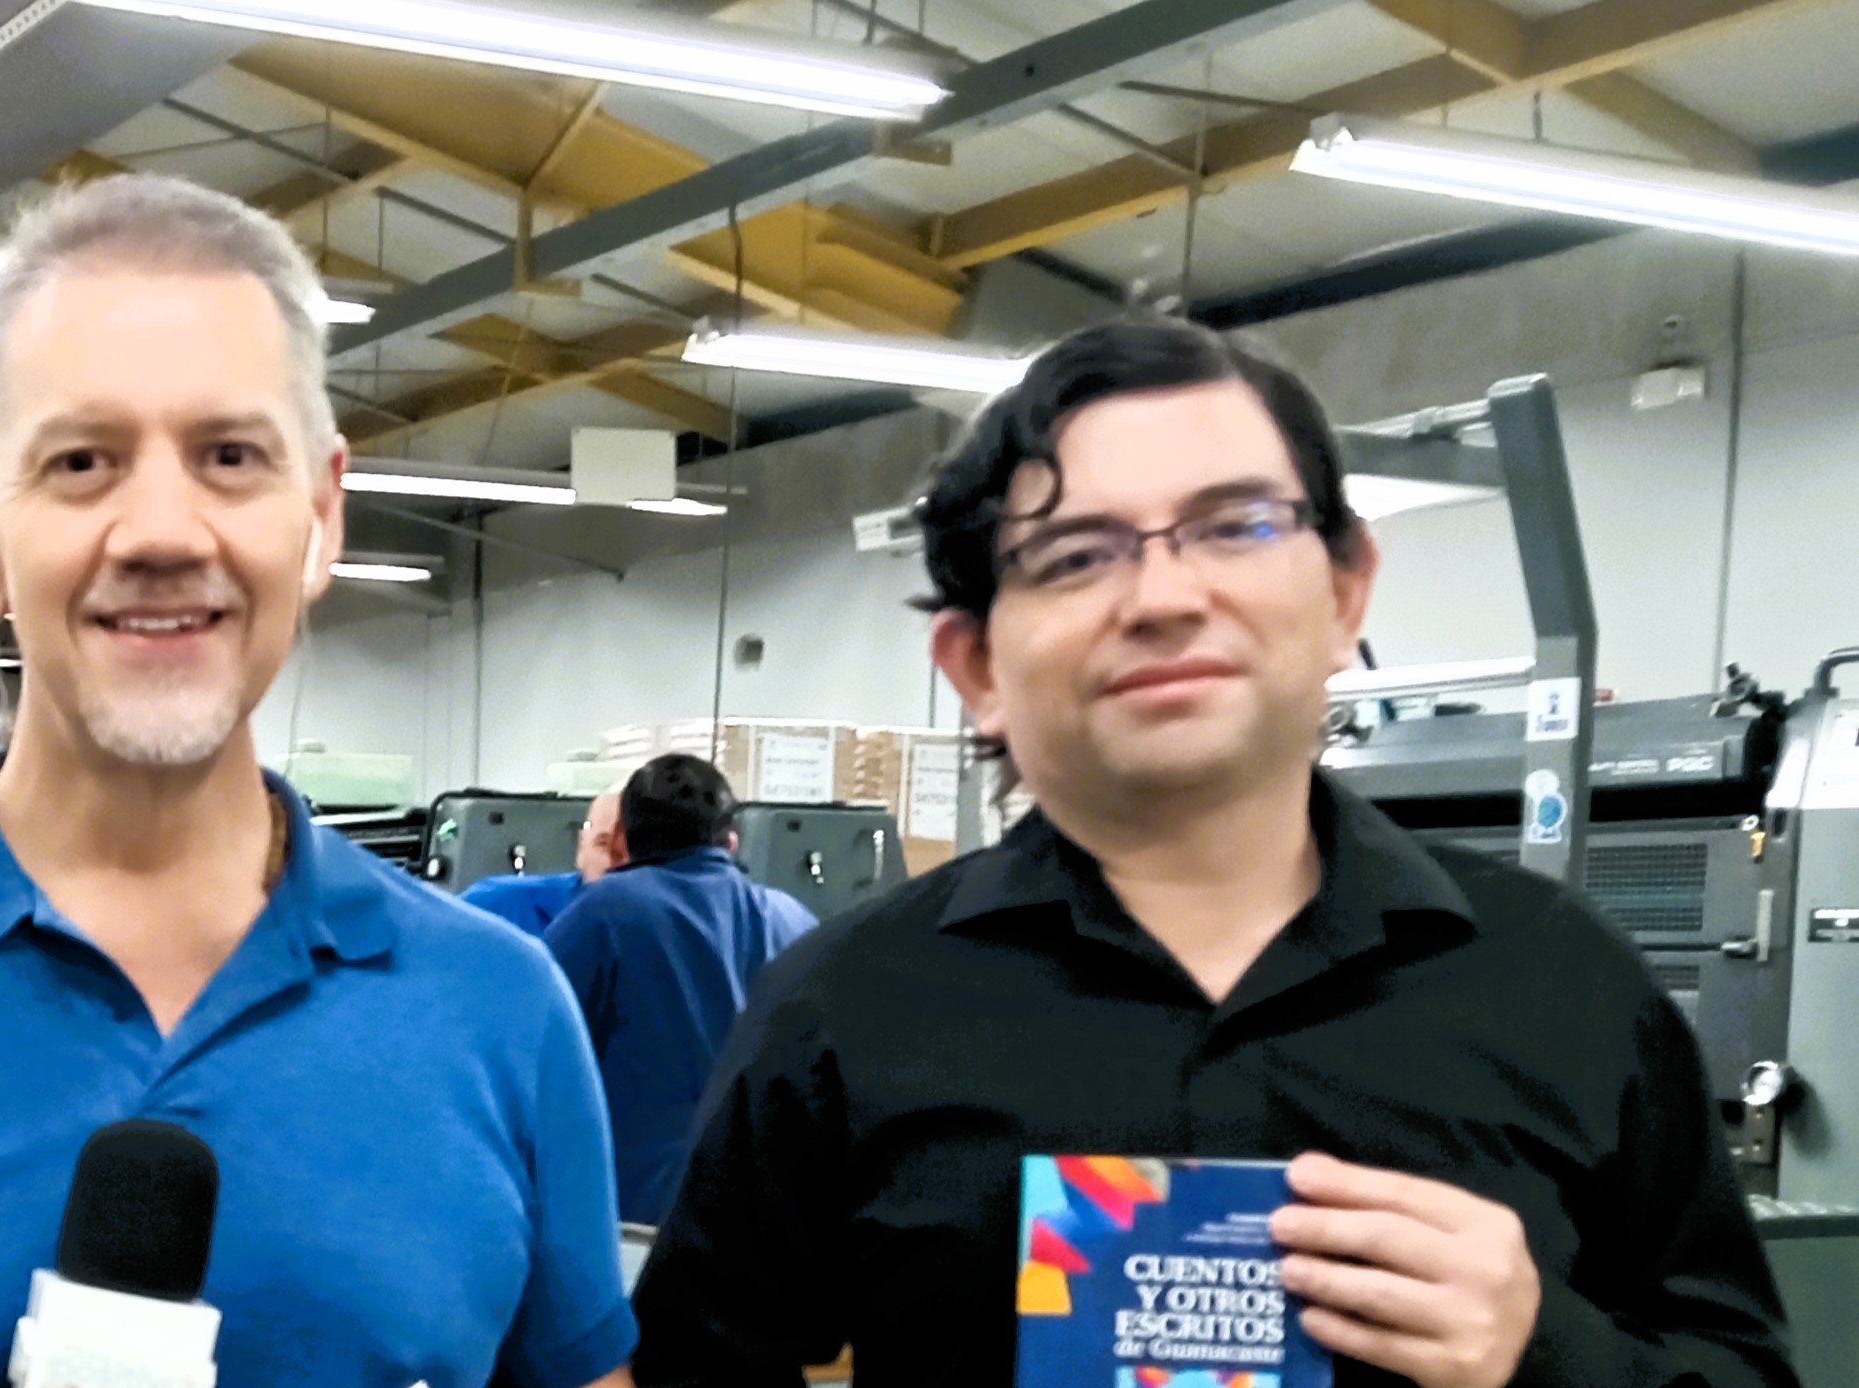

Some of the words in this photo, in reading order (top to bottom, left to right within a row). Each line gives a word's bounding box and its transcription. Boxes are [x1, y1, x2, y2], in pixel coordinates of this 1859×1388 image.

[1123, 1254, 1282, 1285] CUENTOS
[1135, 1284, 1162, 1310] Y
[1166, 1286, 1286, 1315] OTROS
[1115, 1309, 1286, 1343] ESCRITOS
